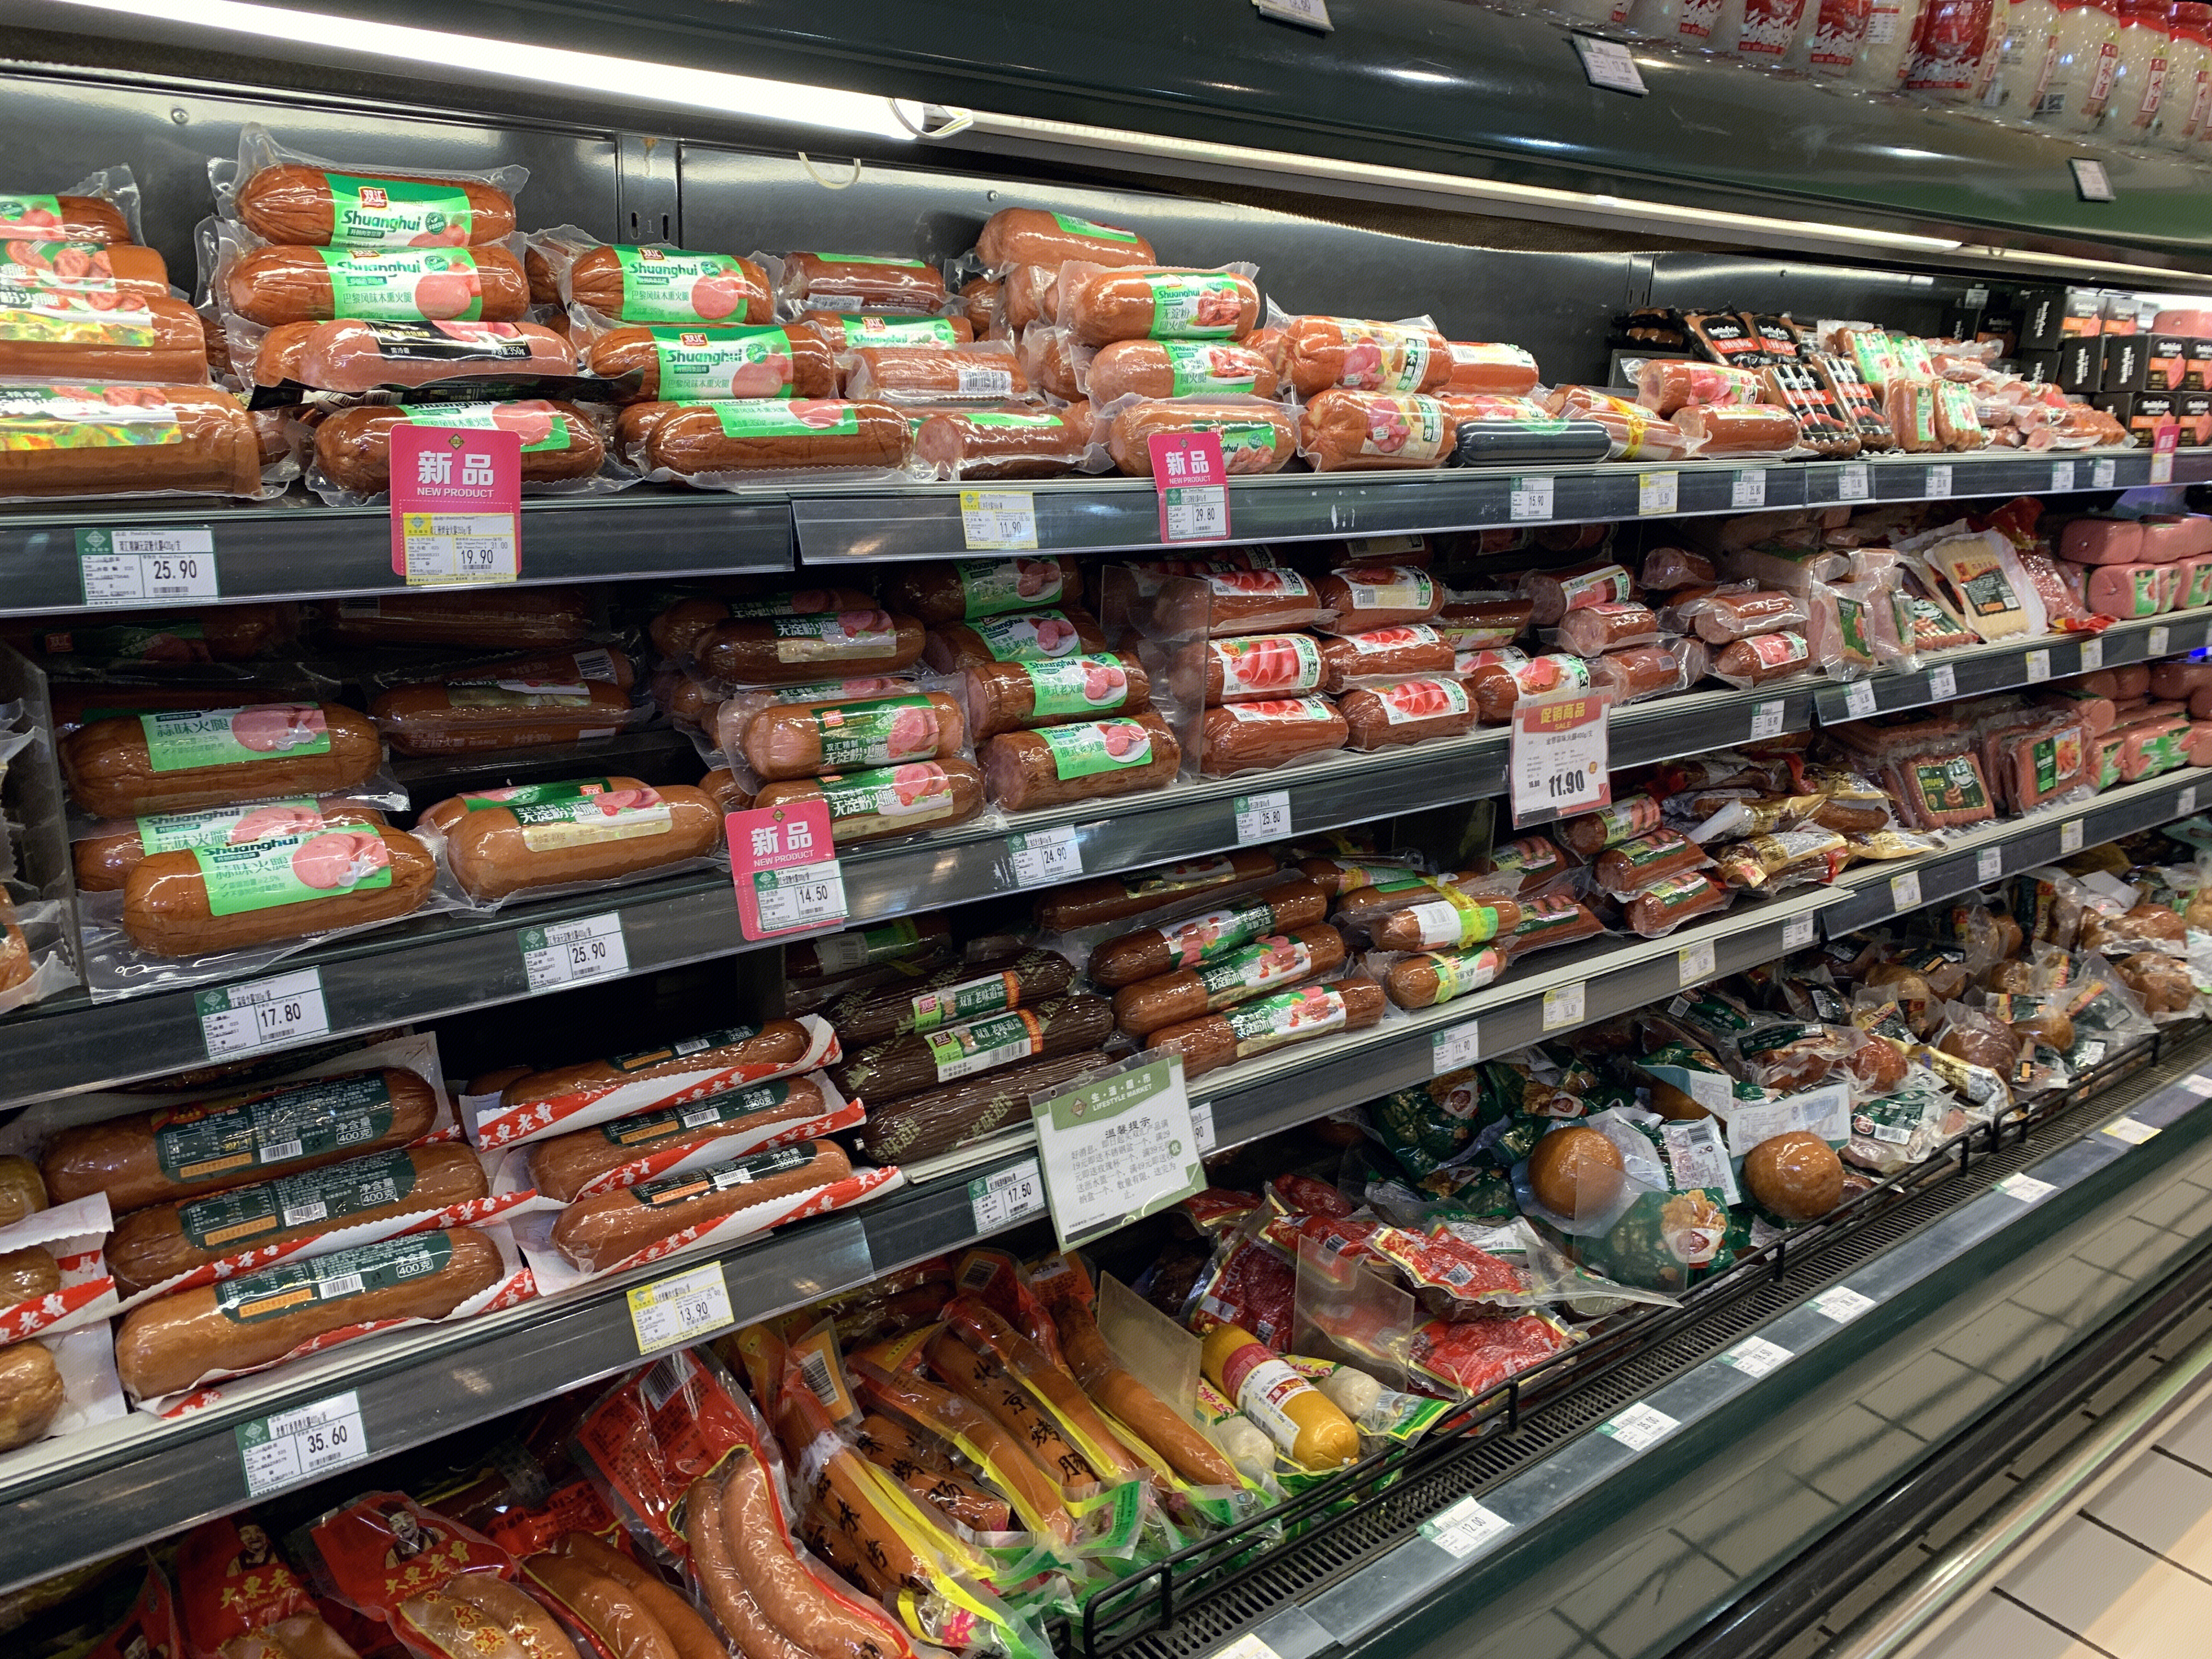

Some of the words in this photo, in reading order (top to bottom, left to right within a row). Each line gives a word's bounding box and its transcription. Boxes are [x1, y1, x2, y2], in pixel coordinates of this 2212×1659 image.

[363, 189, 386, 202] 双汇
[341, 210, 421, 233] Shuanghui
[641, 249, 662, 259] 双汇
[337, 260, 421, 278] Shuanghui
[629, 262, 698, 278] Shuanghui
[343, 292, 412, 304] 巴黎风味木熏火腿
[631, 290, 689, 301] 巴黎风味木熏火腿
[1158, 287, 1200, 301] Shuanghui
[1161, 308, 1190, 320] 无淀粉
[1159, 320, 1188, 332] 圆火腿
[683, 335, 705, 345] 双汇
[665, 349, 742, 366] Shuanghui
[668, 378, 730, 389] 巴黎风味木熏火腿
[417, 450, 494, 486] 新品
[1165, 450, 1210, 476] 新品
[1169, 477, 1183, 485] NEW
[1184, 475, 1211, 484] PRODUCT
[417, 487, 441, 496] NEW
[444, 488, 494, 498] PRODUCT
[1530, 495, 1544, 507] 15.90
[1196, 507, 1215, 522] 29.80
[1000, 521, 1022, 533] 11.90
[461, 549, 493, 565] 19.90
[154, 560, 197, 580] 25.90
[777, 622, 844, 636] 无淀粉火腿
[978, 618, 1025, 634] Shuanghui
[1029, 658, 1076, 670] Shuanghui
[825, 711, 842, 723] 双汇
[1541, 702, 1585, 725] 促销商品
[156, 718, 230, 737] 蒜味火腿
[1042, 722, 1092, 735] Shuanghui
[1554, 721, 1572, 731] SALE
[823, 743, 888, 766] 无淀粉火腿
[825, 741, 859, 752] 双汇精制
[1548, 769, 1585, 798] 11.90
[520, 800, 601, 824] 无淀粉火腿
[833, 792, 899, 817] 无淀粉火腿
[144, 808, 241, 826] Shuanghui
[1262, 810, 1280, 825] 25.80
[155, 830, 228, 853] 蒜味火腿
[201, 836, 300, 857] Shuanghui
[751, 821, 813, 857] 新品
[753, 856, 773, 868] NEW
[775, 849, 815, 864] PRODUCT
[1043, 847, 1067, 864] 24.90
[215, 856, 289, 879] 蒜味火腿
[799, 885, 828, 904] 14.50
[572, 941, 606, 964] 25.90
[261, 1002, 302, 1028] 17.80
[933, 1034, 950, 1044] 双汇
[1093, 1093, 1126, 1111] LIFESTYLE
[1127, 1083, 1152, 1099] MARKET
[335, 1117, 372, 1132] 净含量
[1105, 1117, 1150, 1138] 温馨提示
[338, 1128, 372, 1142] 400克
[359, 1178, 394, 1193] 净含量
[1008, 1183, 1032, 1203] 17.50
[362, 1188, 396, 1204] 400克
[398, 1261, 432, 1276] 400克
[680, 1301, 708, 1322] 13.90
[307, 1425, 347, 1453] 35.60
[1462, 1516, 1485, 1536] 12.00
